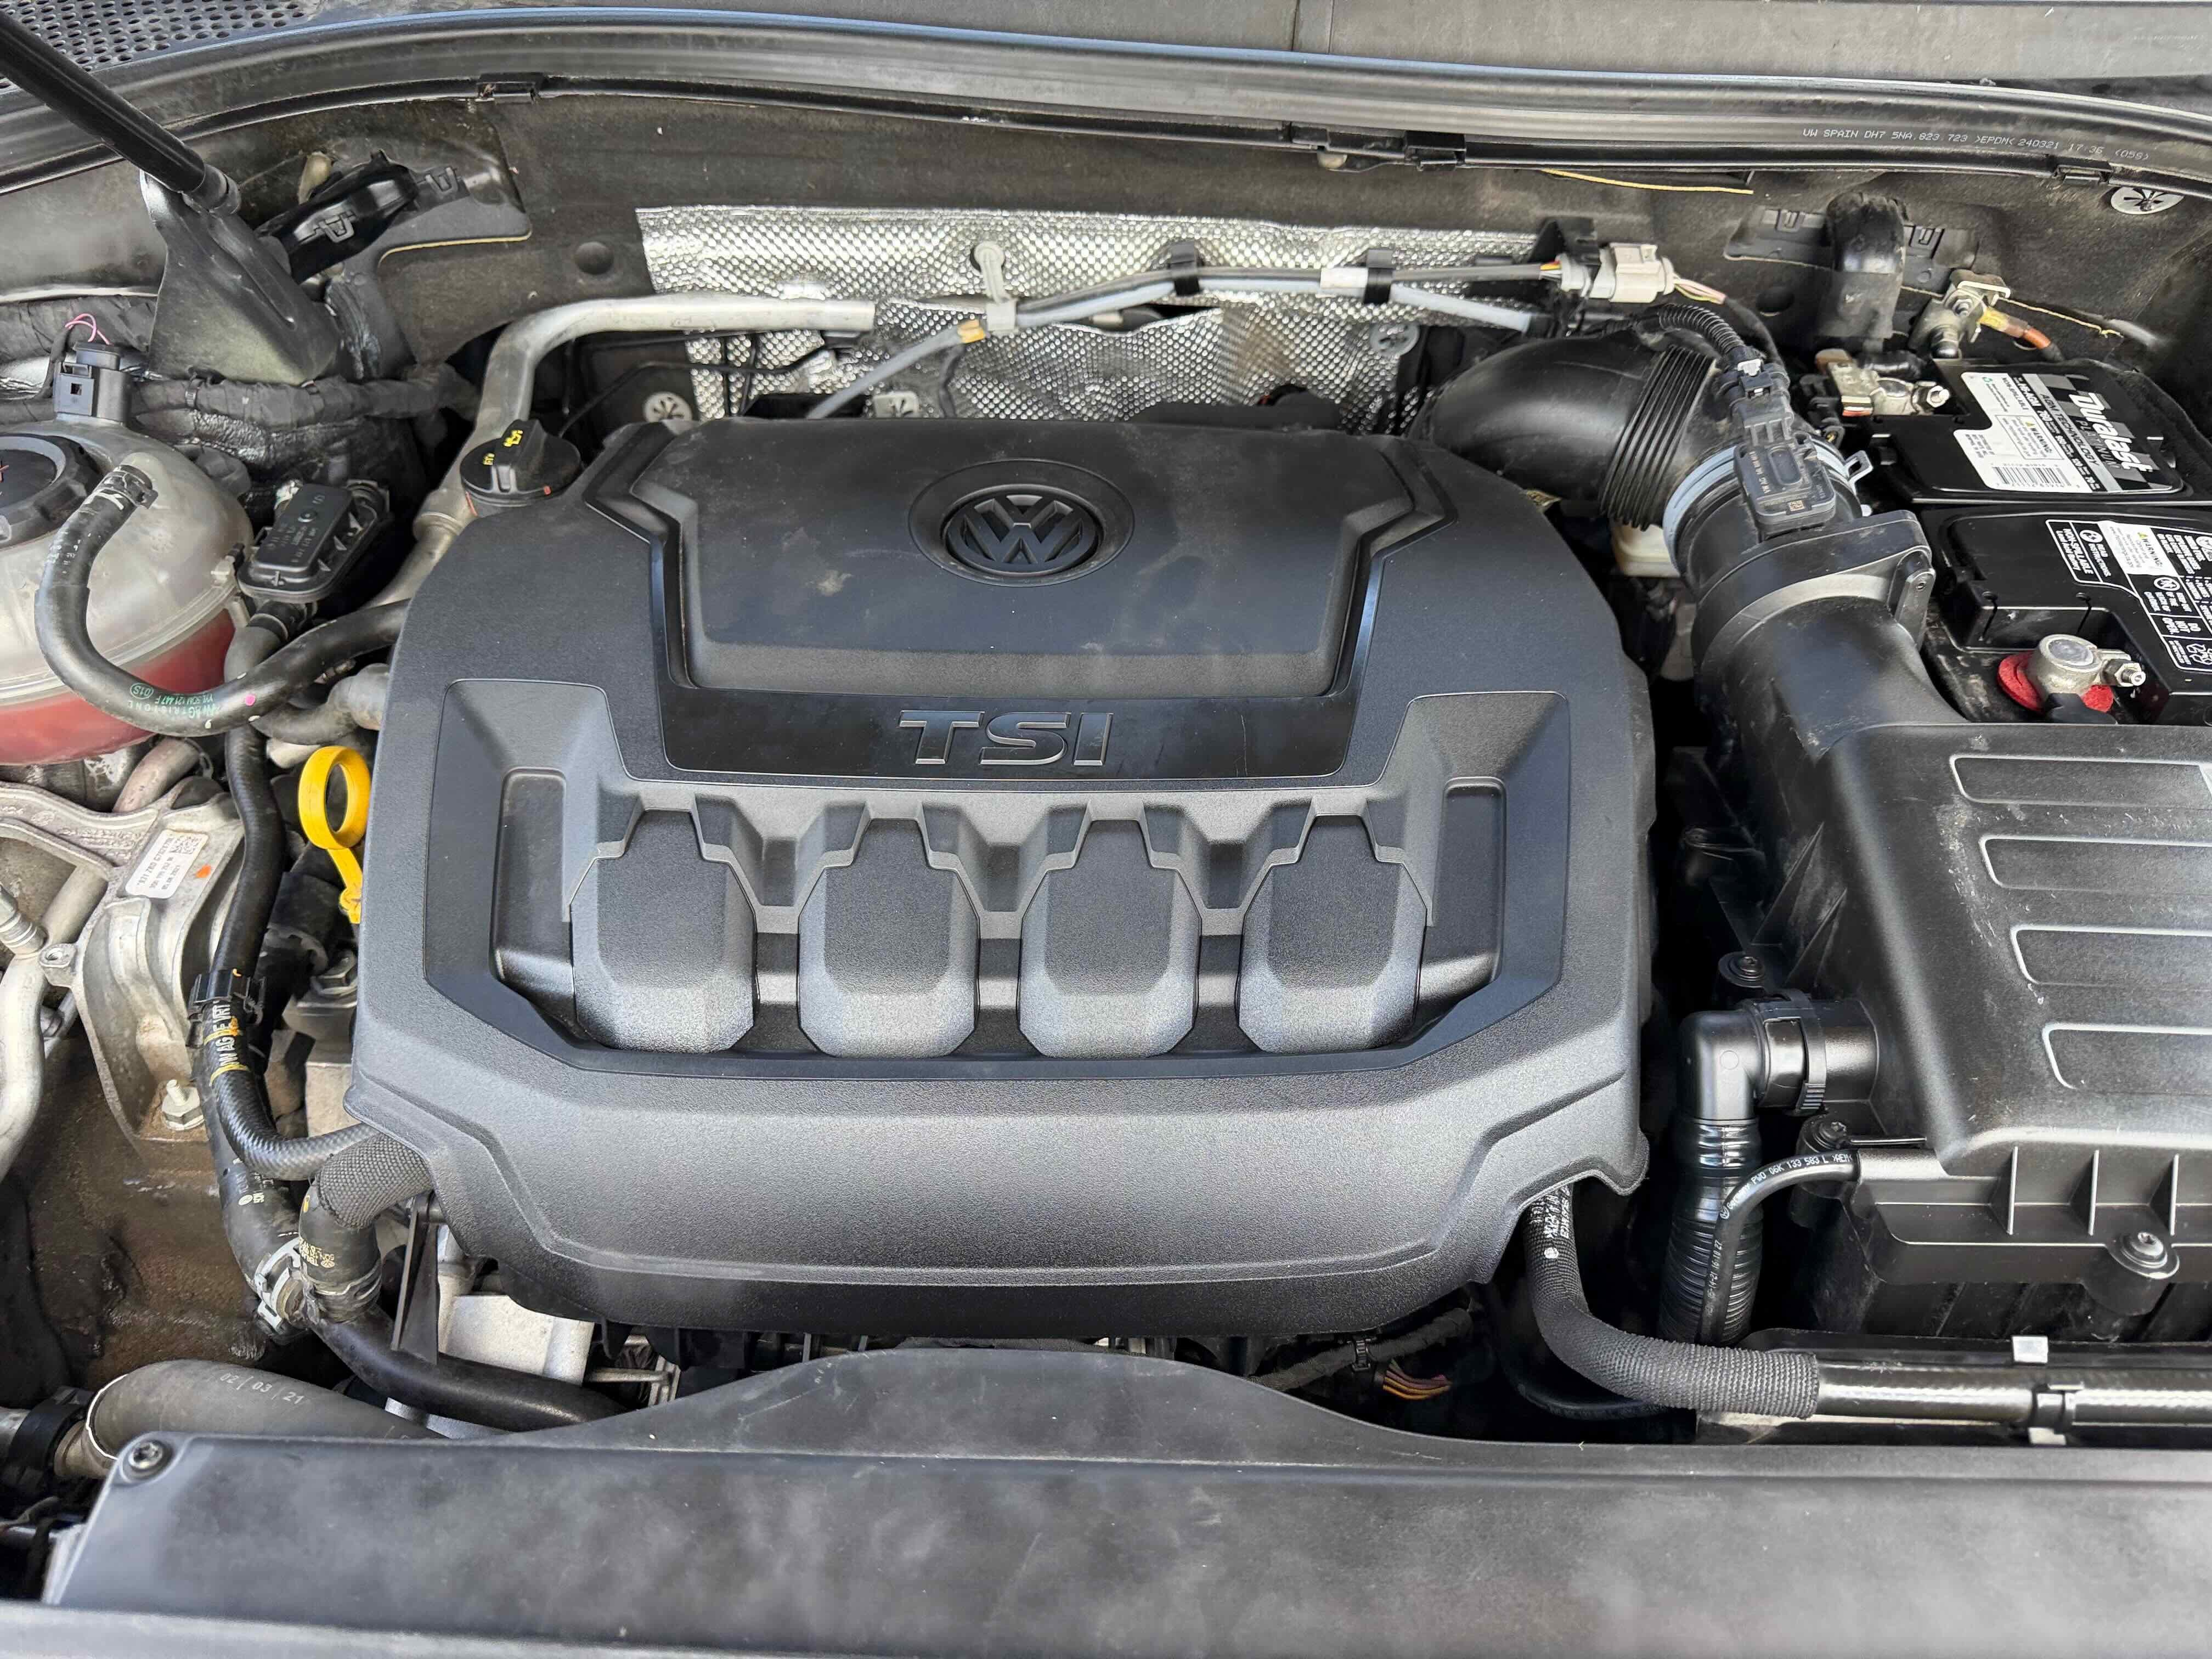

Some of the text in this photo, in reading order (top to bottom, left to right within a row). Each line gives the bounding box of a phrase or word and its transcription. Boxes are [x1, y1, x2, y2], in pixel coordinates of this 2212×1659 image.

[1824, 129, 1859, 138] SPAIN
[2017, 138, 2059, 150] 240321
[2040, 393, 2060, 411] AGM
[2054, 413, 2100, 466] TECHNOLOGY
[2068, 392, 2153, 472] Duralast
[2075, 420, 2121, 469] PLATINUM
[957, 490, 1092, 568] VW
[2056, 531, 2068, 543] Lead
[2063, 528, 2094, 574] NON-SPILLABLE
[2174, 620, 2191, 633] NOT
[2187, 623, 2202, 631] DO
[899, 710, 1115, 766] TSI
[1786, 1159, 1802, 1169] 133
[1805, 1155, 1820, 1166] 583
[1822, 1156, 1829, 1164] L
